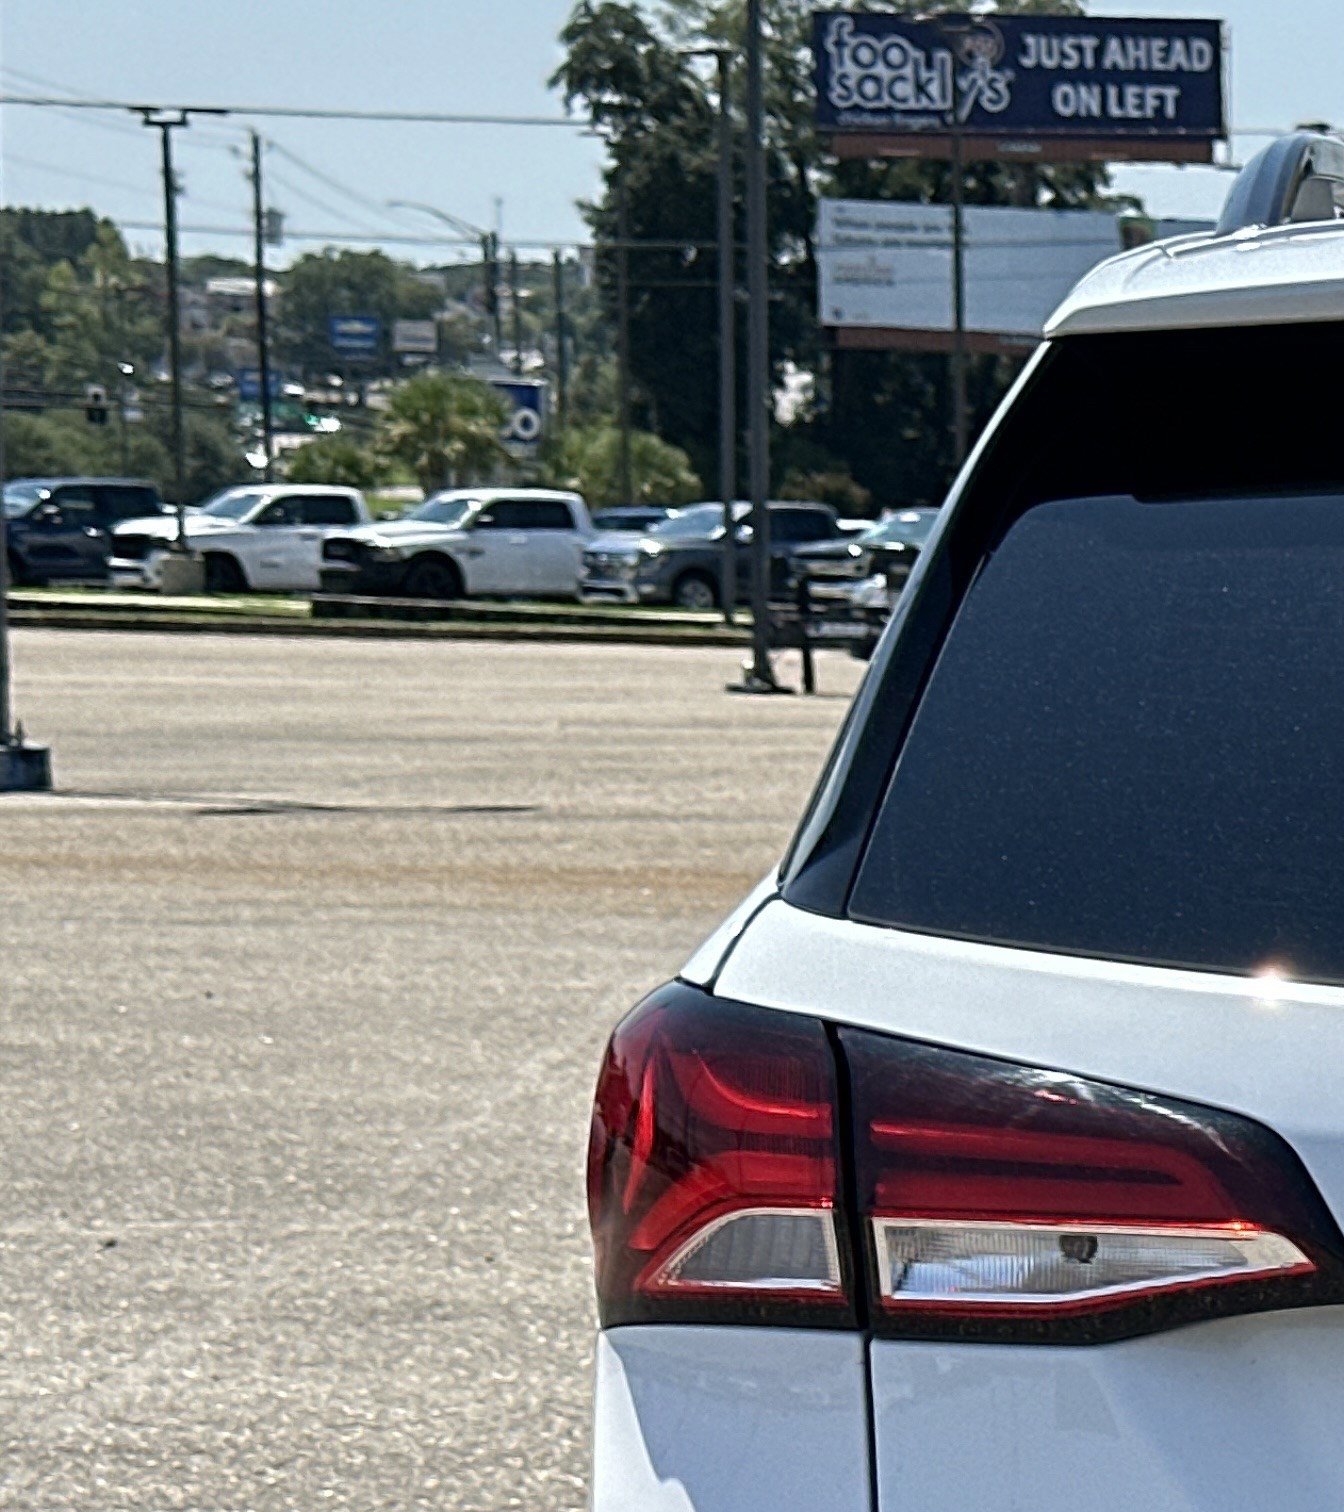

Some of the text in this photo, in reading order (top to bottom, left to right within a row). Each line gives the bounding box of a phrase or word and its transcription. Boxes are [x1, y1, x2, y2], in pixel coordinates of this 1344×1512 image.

[828, 17, 913, 70] foo
[1018, 34, 1213, 72] JUST AHEAD
[1052, 83, 1180, 119] ON LEFT
